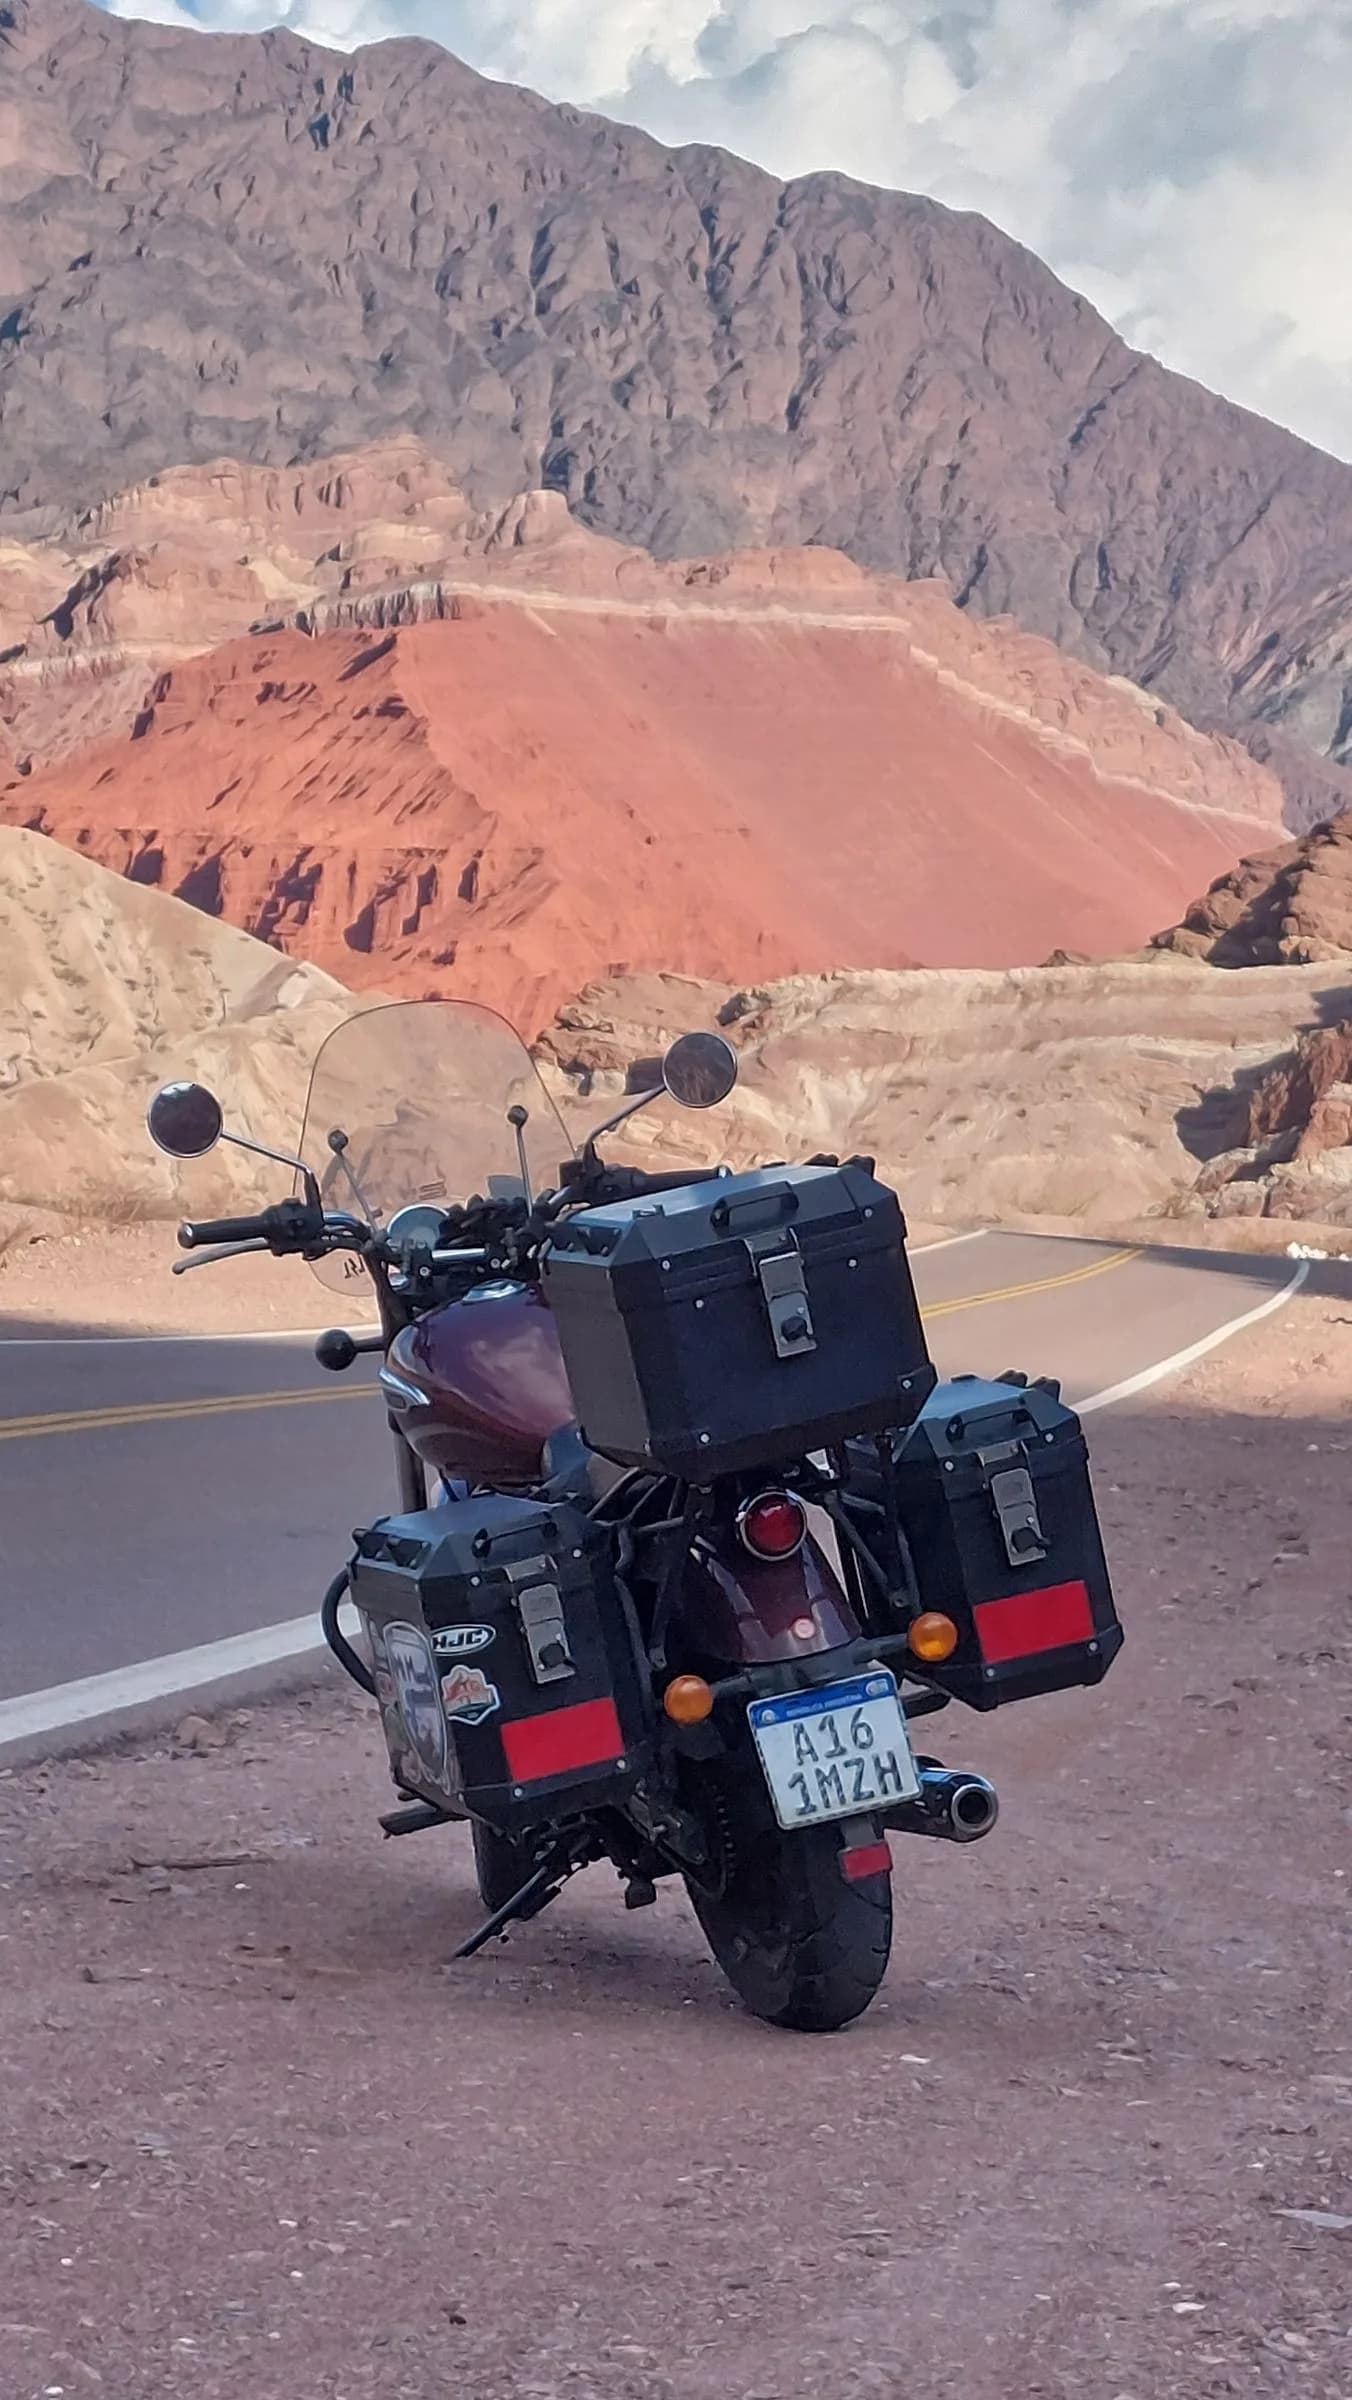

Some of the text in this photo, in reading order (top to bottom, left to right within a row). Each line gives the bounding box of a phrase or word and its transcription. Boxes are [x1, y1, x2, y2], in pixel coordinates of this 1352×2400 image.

[432, 1629, 484, 1650] HJC
[793, 1707, 874, 1767] A16
[788, 1751, 903, 1816] 1MZH
